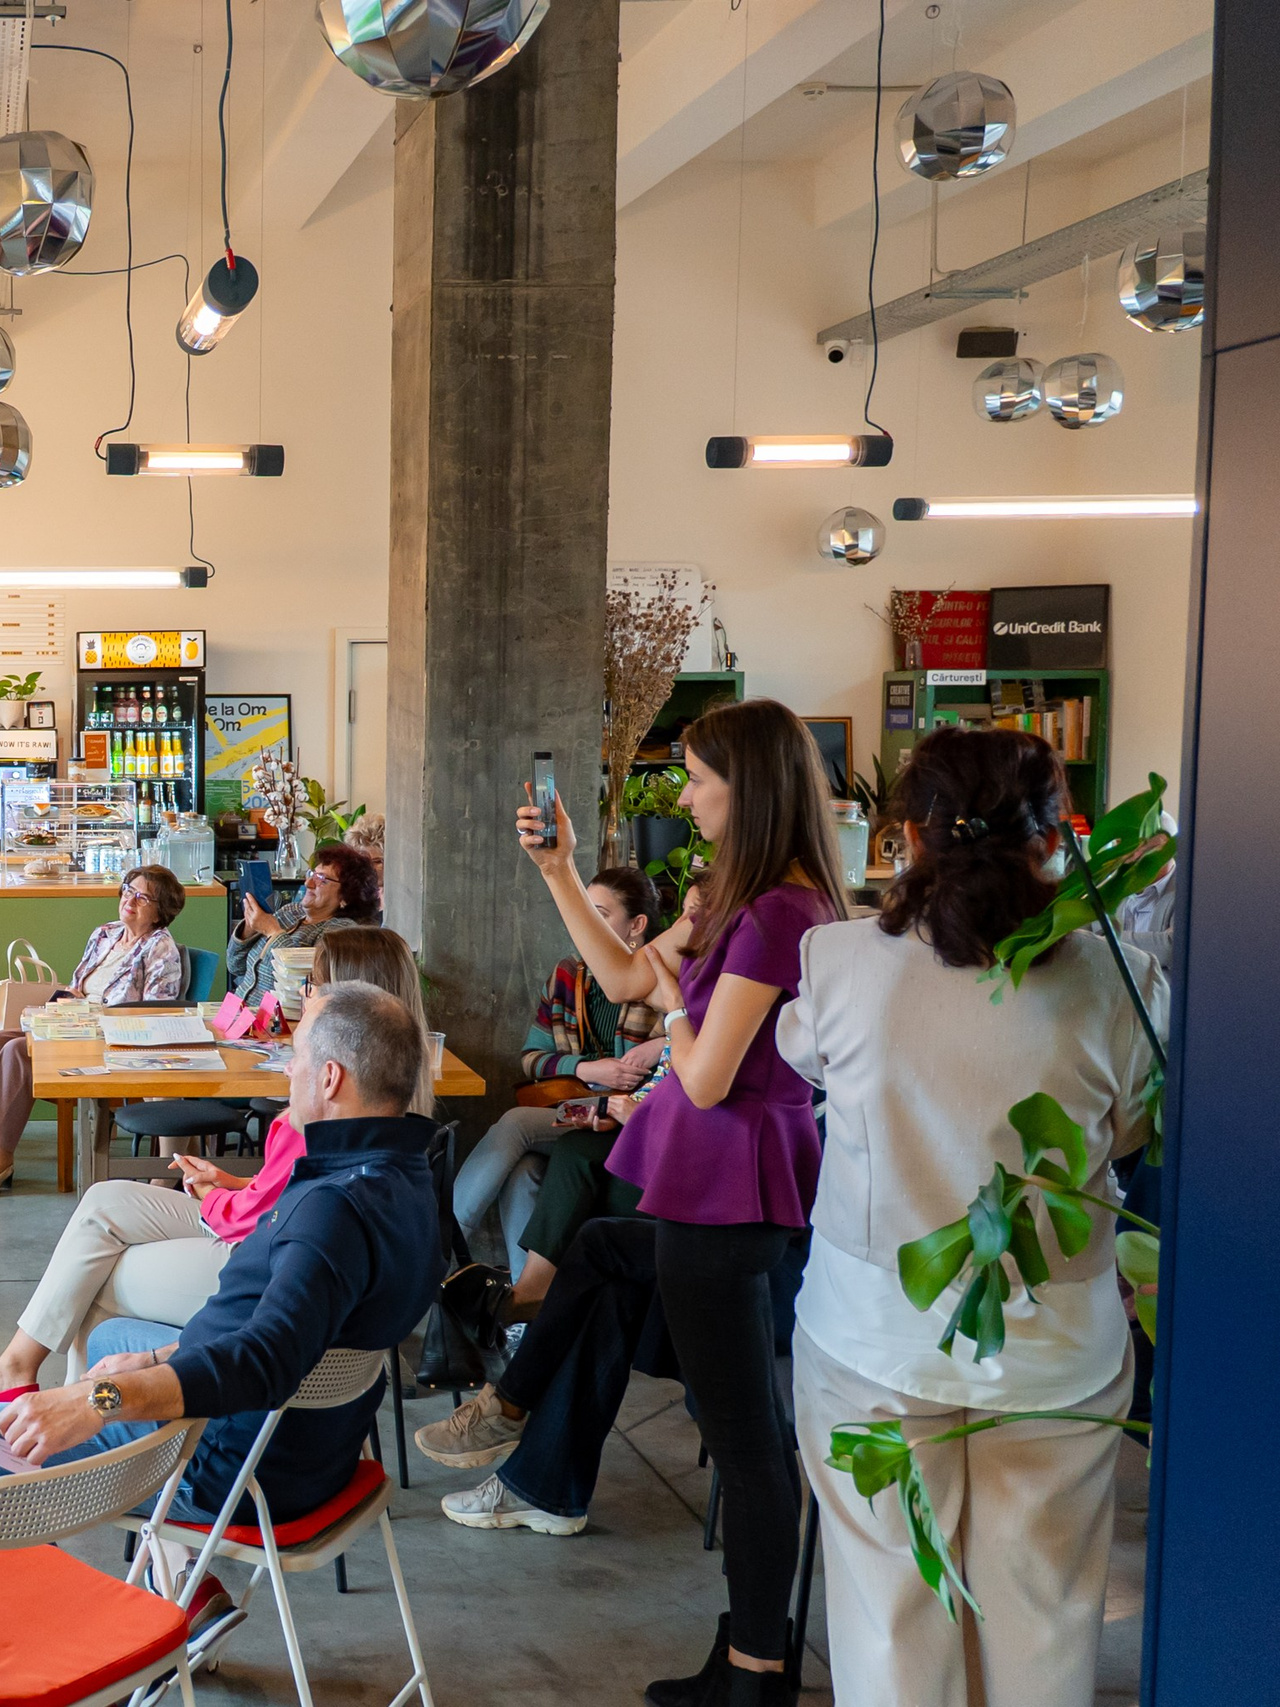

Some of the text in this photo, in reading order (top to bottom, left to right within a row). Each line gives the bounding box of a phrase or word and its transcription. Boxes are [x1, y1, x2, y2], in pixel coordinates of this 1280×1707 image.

[1008, 620, 1102, 634] UniCredit Bank
[931, 672, 983, 683] Cărturești
[221, 702, 234, 716] la
[238, 702, 267, 716] Om
[213, 718, 242, 731] Om
[33, 741, 52, 749] RAW!
